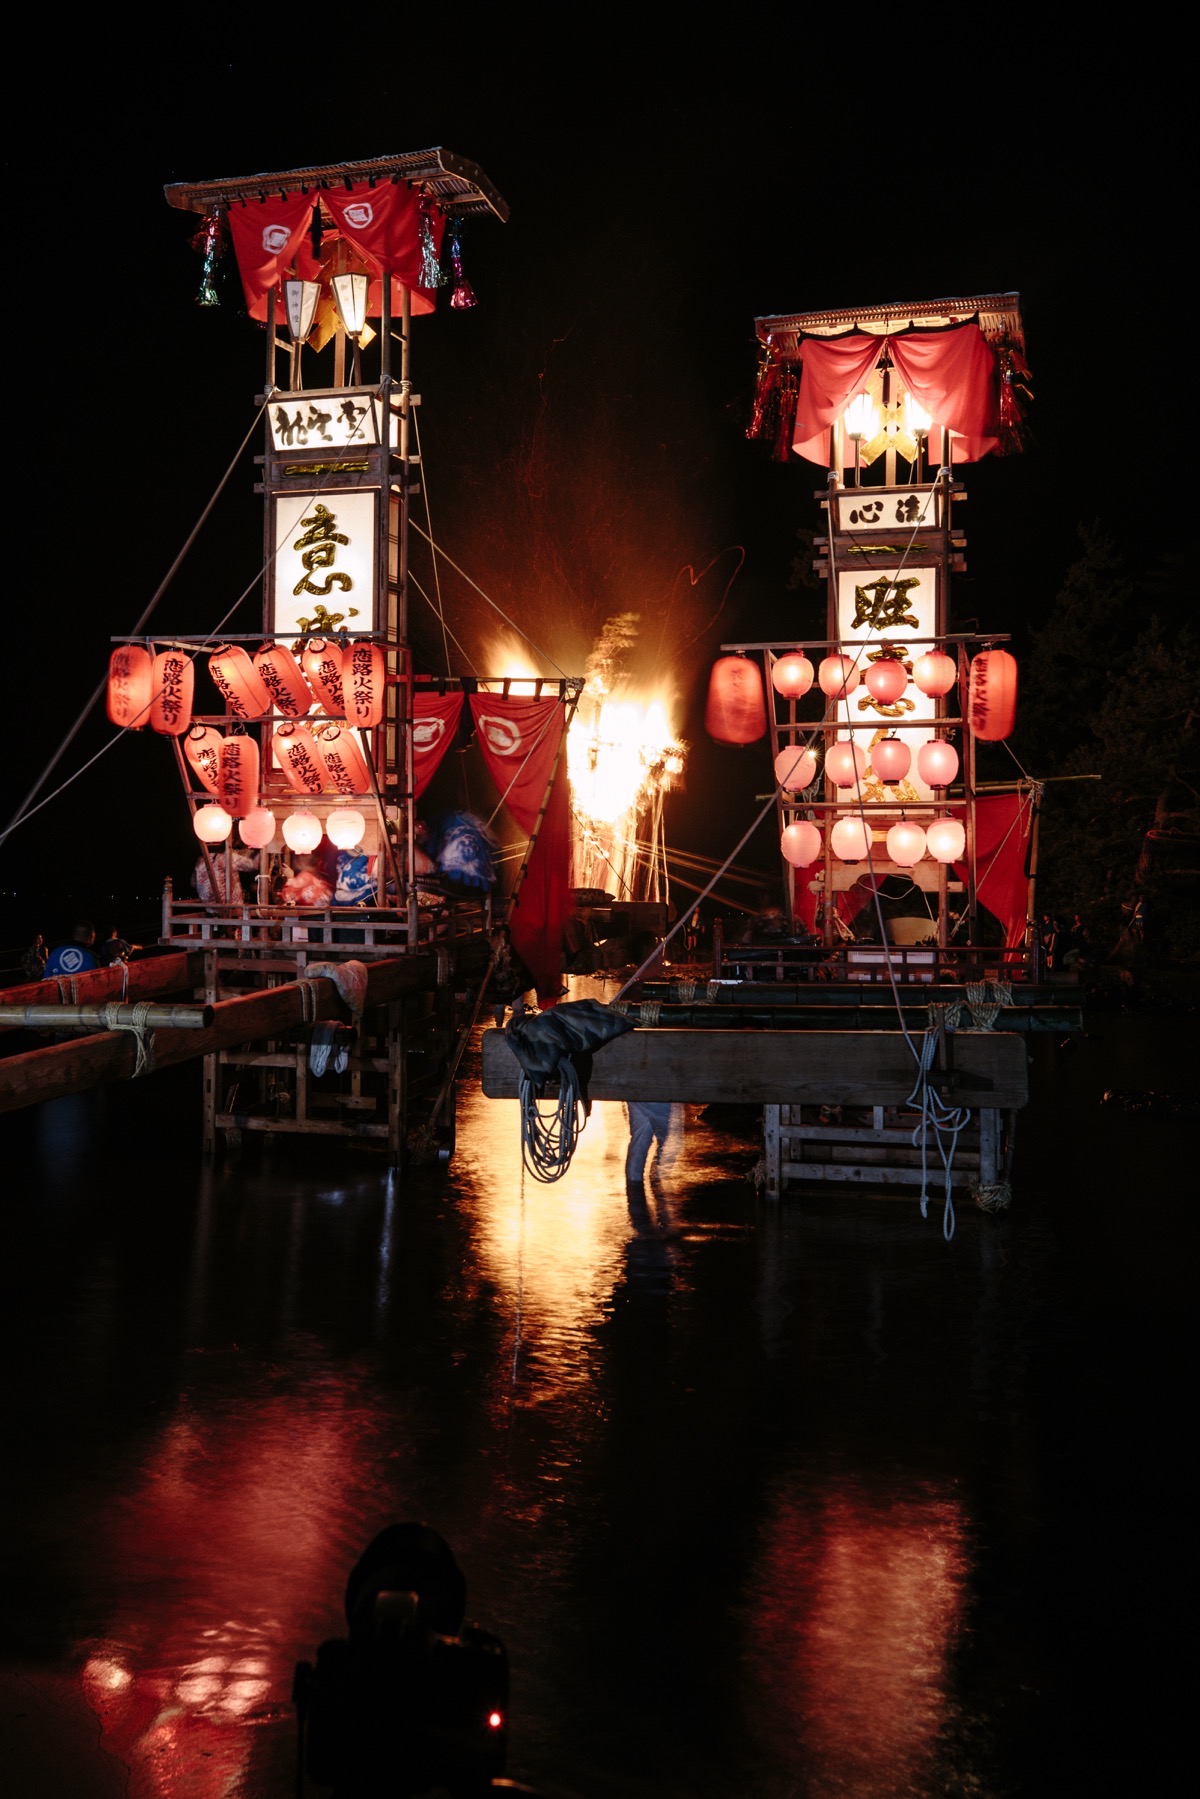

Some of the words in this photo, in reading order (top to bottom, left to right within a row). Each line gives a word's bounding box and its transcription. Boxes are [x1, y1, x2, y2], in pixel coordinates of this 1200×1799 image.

[162, 658, 184, 726] 恋路火祭り
[259, 662, 299, 717] 恋路火祭り
[318, 659, 345, 711] 恋路火祭
[351, 647, 374, 718] 恋路火祭り
[222, 742, 243, 809] 恋路火祭り
[287, 742, 324, 794] 恋路火祭り
